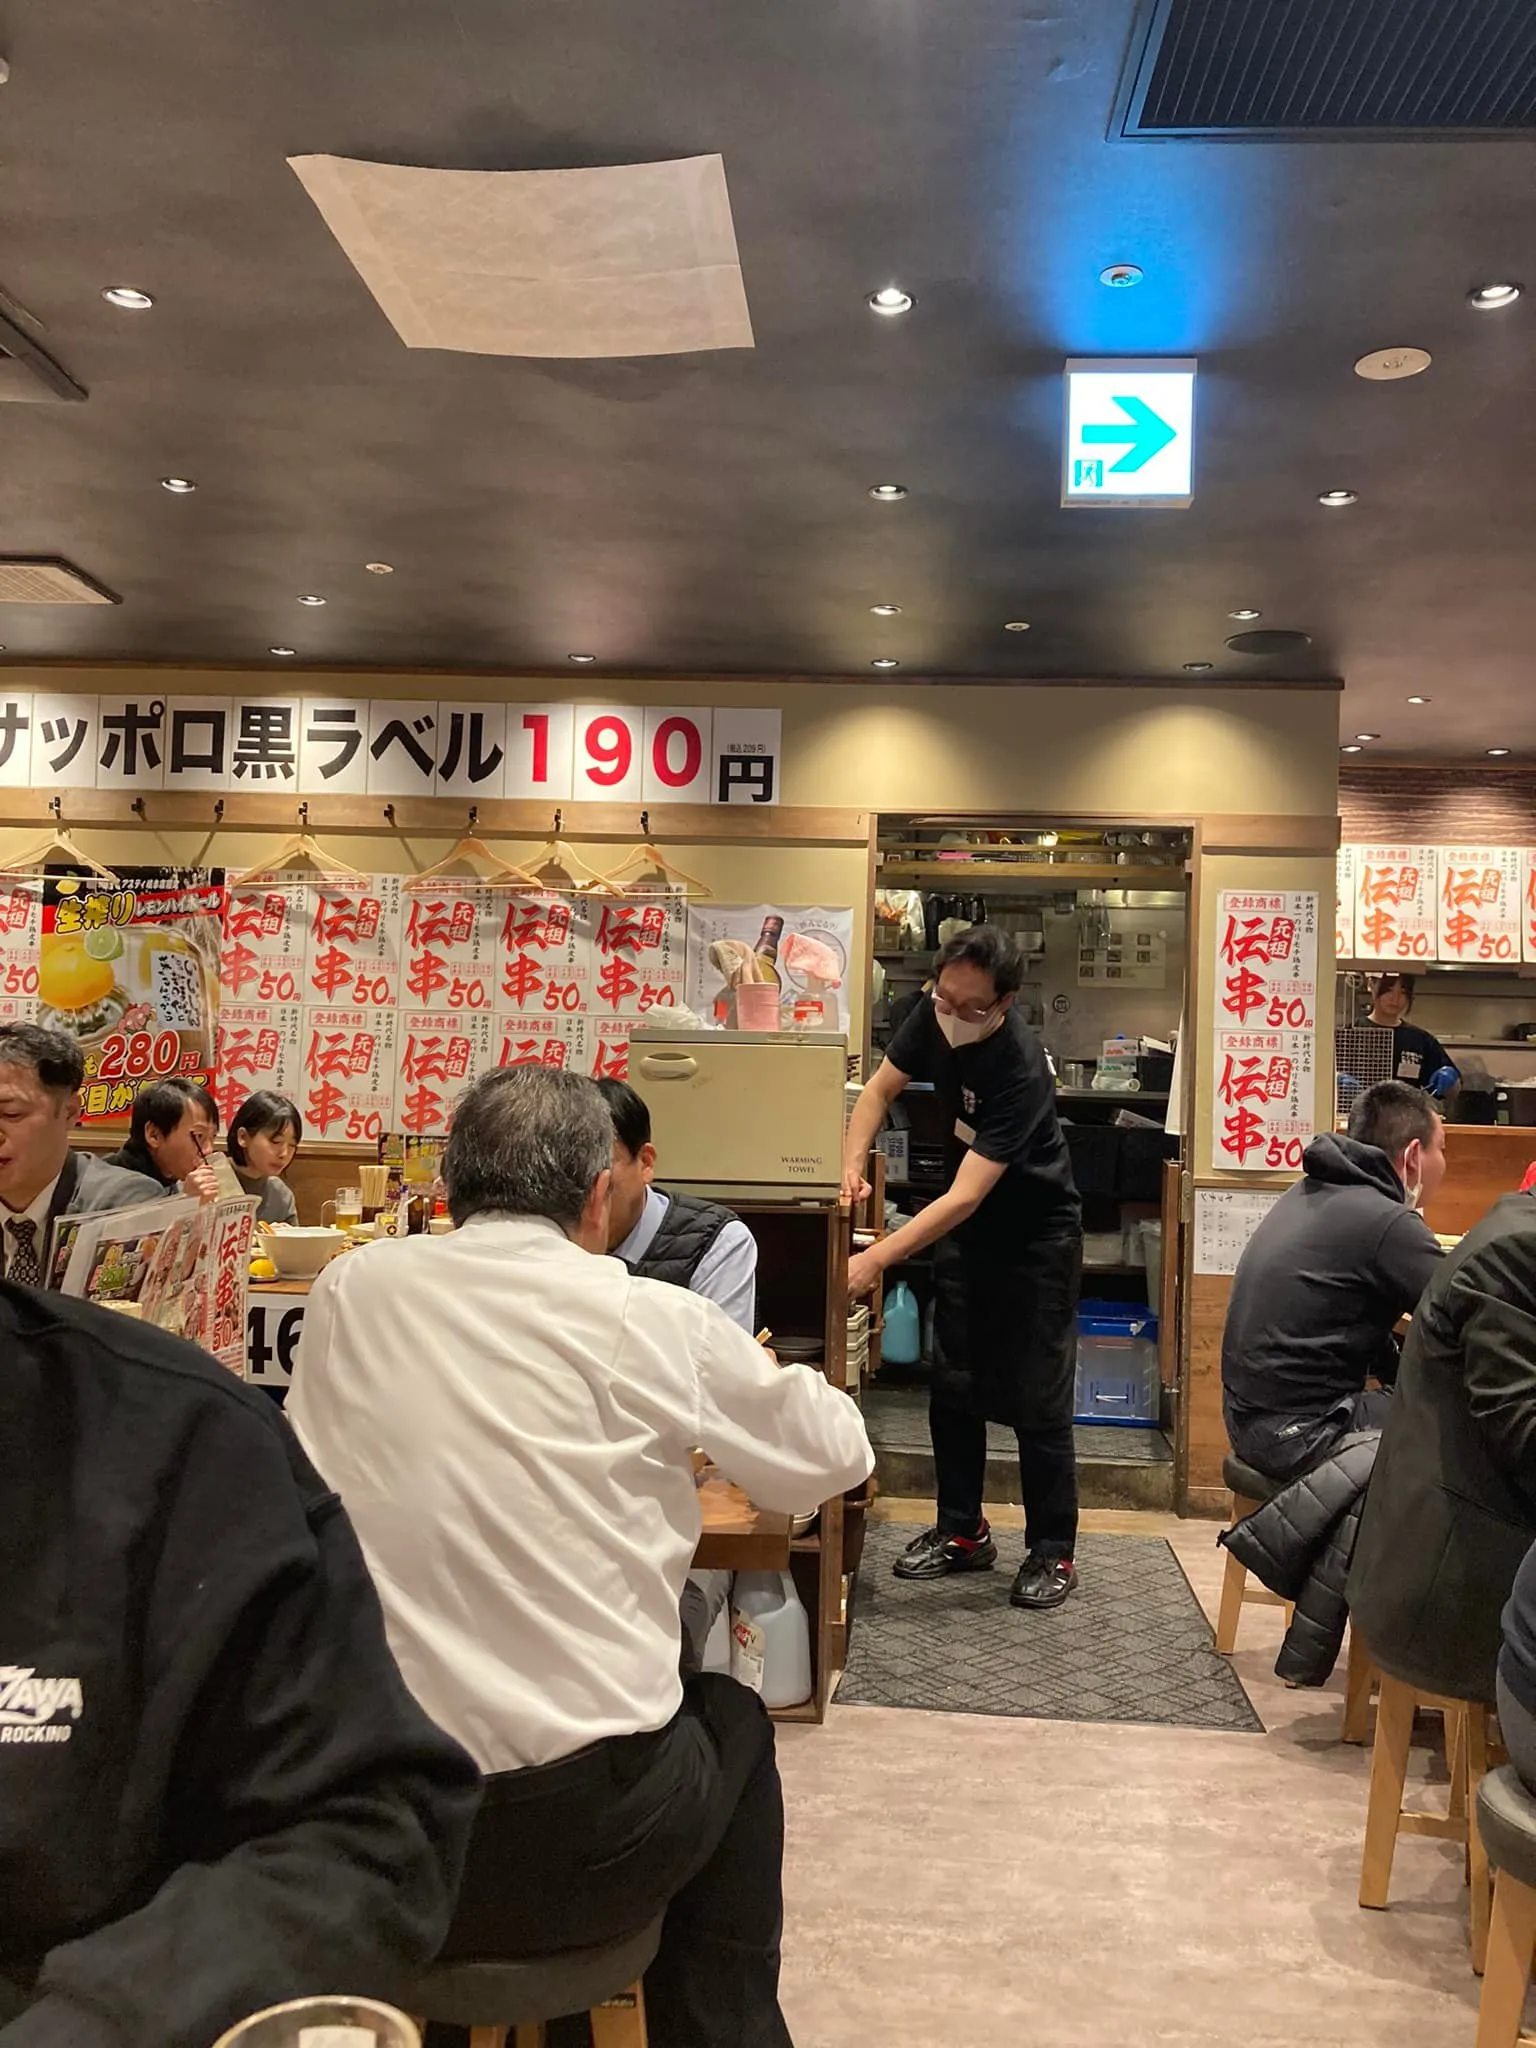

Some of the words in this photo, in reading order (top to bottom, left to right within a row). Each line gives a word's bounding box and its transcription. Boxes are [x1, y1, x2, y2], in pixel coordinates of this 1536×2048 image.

[1230, 897, 1280, 909] 登録商標
[1397, 867, 1418, 900] 元祖
[8, 889, 30, 927] 元祖
[262, 895, 285, 934] 元祖
[356, 899, 379, 938] 元祖
[450, 903, 473, 941] 元祖
[546, 906, 569, 945] 元祖
[640, 908, 664, 947] 元祖
[1359, 865, 1399, 956] 伝串
[1442, 867, 1482, 958] 伝串
[220, 892, 264, 999] 伝串
[311, 894, 359, 1002] 伝串
[405, 899, 452, 1006] 伝串
[500, 902, 548, 1010] 伝串
[1267, 919, 1293, 958] 元祖
[594, 904, 642, 1013] 伝串
[1220, 915, 1271, 1025] 伝串
[1266, 995, 1314, 1028] 50円
[255, 1030, 279, 1069] 元祖
[350, 1034, 373, 1072] 元祖
[445, 1038, 469, 1076] 元祖
[1226, 1036, 1278, 1048] 登録商標
[217, 1025, 258, 1132] 伝串
[304, 1029, 352, 1137] 伝串
[399, 1034, 447, 1133] 伝串
[1265, 1058, 1290, 1098] 元祖
[1217, 1054, 1269, 1165] 伝串
[781, 1156, 822, 1164] WARMING
